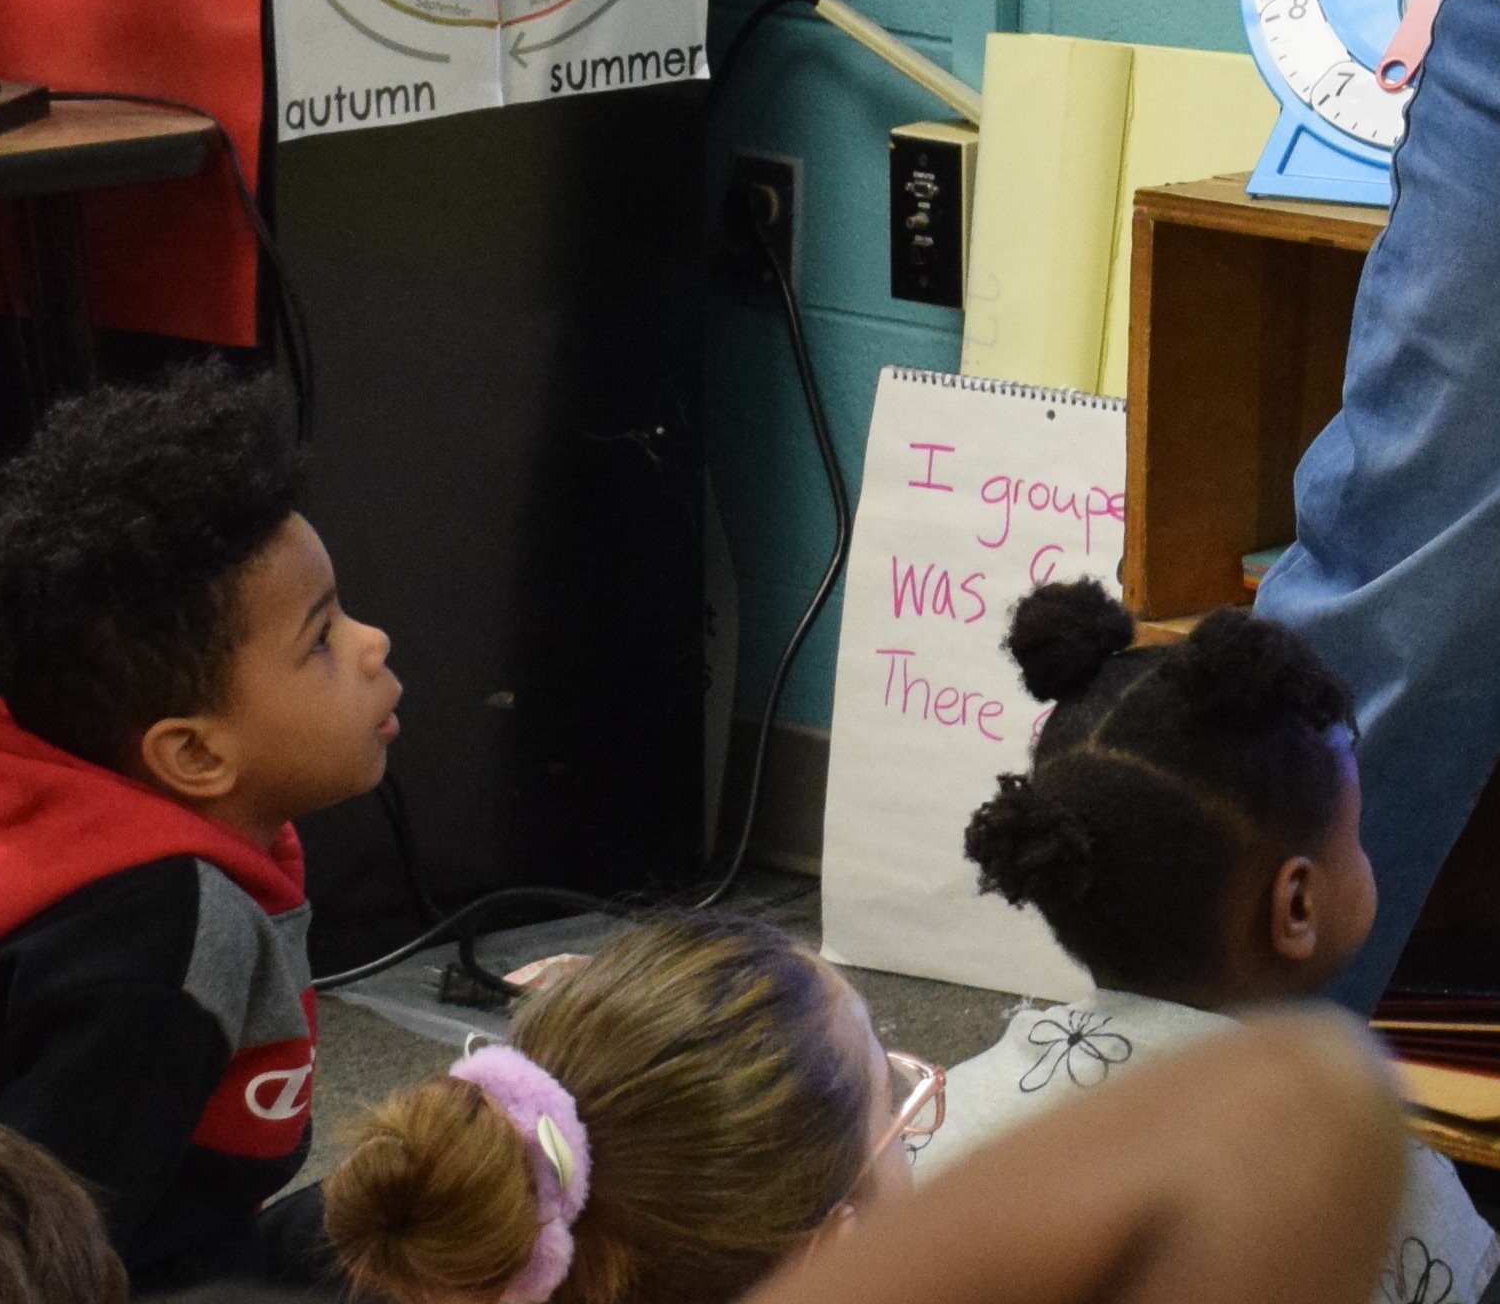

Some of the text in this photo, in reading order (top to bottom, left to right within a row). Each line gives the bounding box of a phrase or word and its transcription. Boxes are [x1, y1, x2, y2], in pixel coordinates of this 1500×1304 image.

[550, 40, 705, 94] summer
[1334, 71, 1356, 99] 7
[285, 79, 437, 131] autumn
[909, 441, 1127, 556] I groupe
[875, 647, 1005, 742] There
